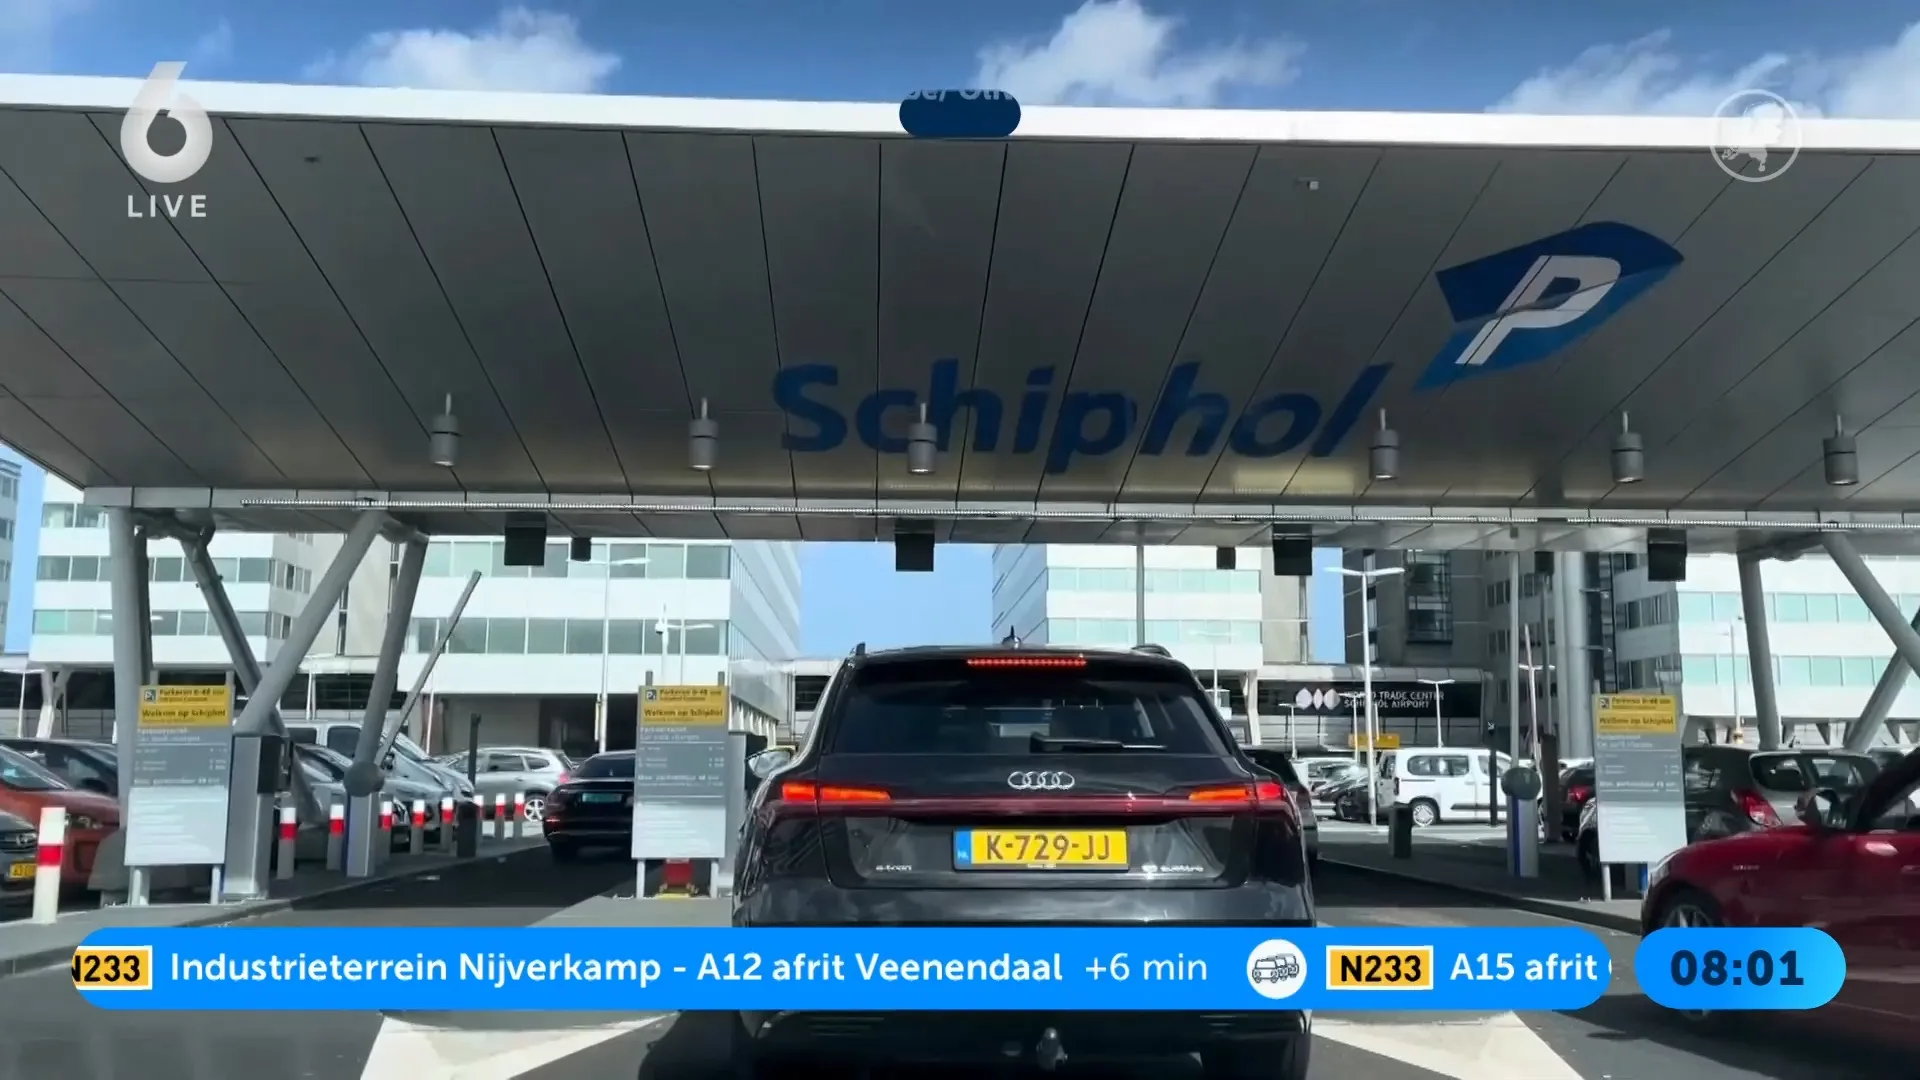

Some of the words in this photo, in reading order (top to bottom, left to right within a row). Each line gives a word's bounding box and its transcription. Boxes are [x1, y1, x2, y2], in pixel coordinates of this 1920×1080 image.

[772, 358, 1395, 474] Schiphol
[1391, 700, 1430, 709] AIRPORT
[986, 834, 1110, 860] K-729-JJ
